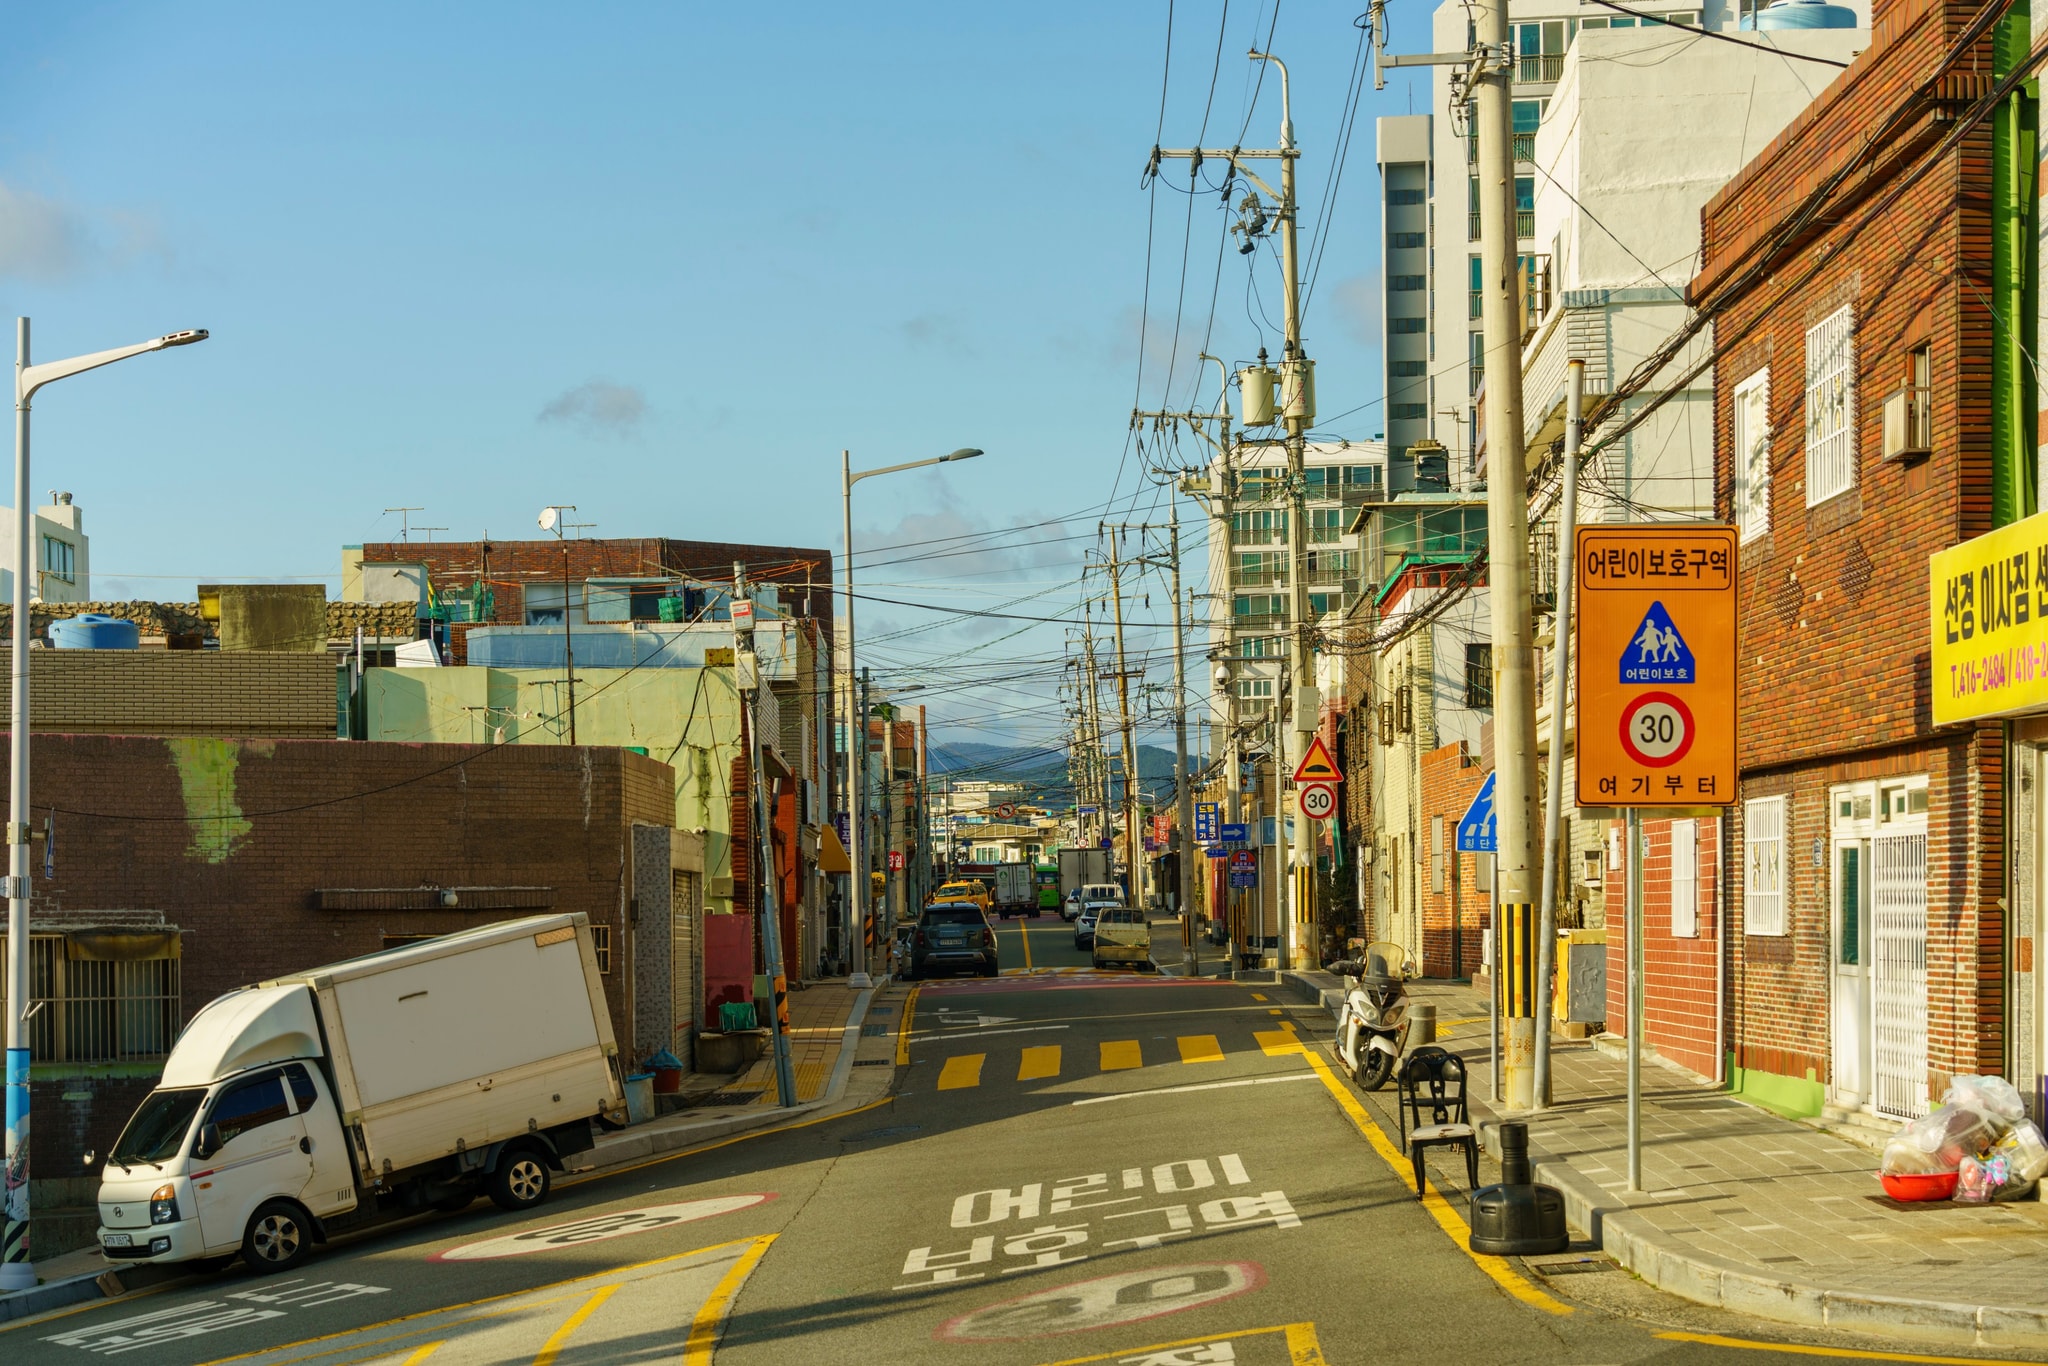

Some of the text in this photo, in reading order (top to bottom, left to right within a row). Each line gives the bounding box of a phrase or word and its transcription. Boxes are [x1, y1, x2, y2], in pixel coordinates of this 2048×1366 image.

[1587, 548, 1728, 579] 어린이보호구역
[1944, 570, 1975, 645] 선경
[1980, 551, 2030, 635] 이사짐
[1625, 668, 1689, 681] 어린이보호
[2015, 640, 2048, 684] 418-2
[1640, 714, 1674, 744] 30
[1307, 793, 1329, 809] 30
[1598, 775, 1716, 796] 여기부터
[950, 1153, 1251, 1228] 어린이
[892, 1190, 1302, 1290] 보호구역
